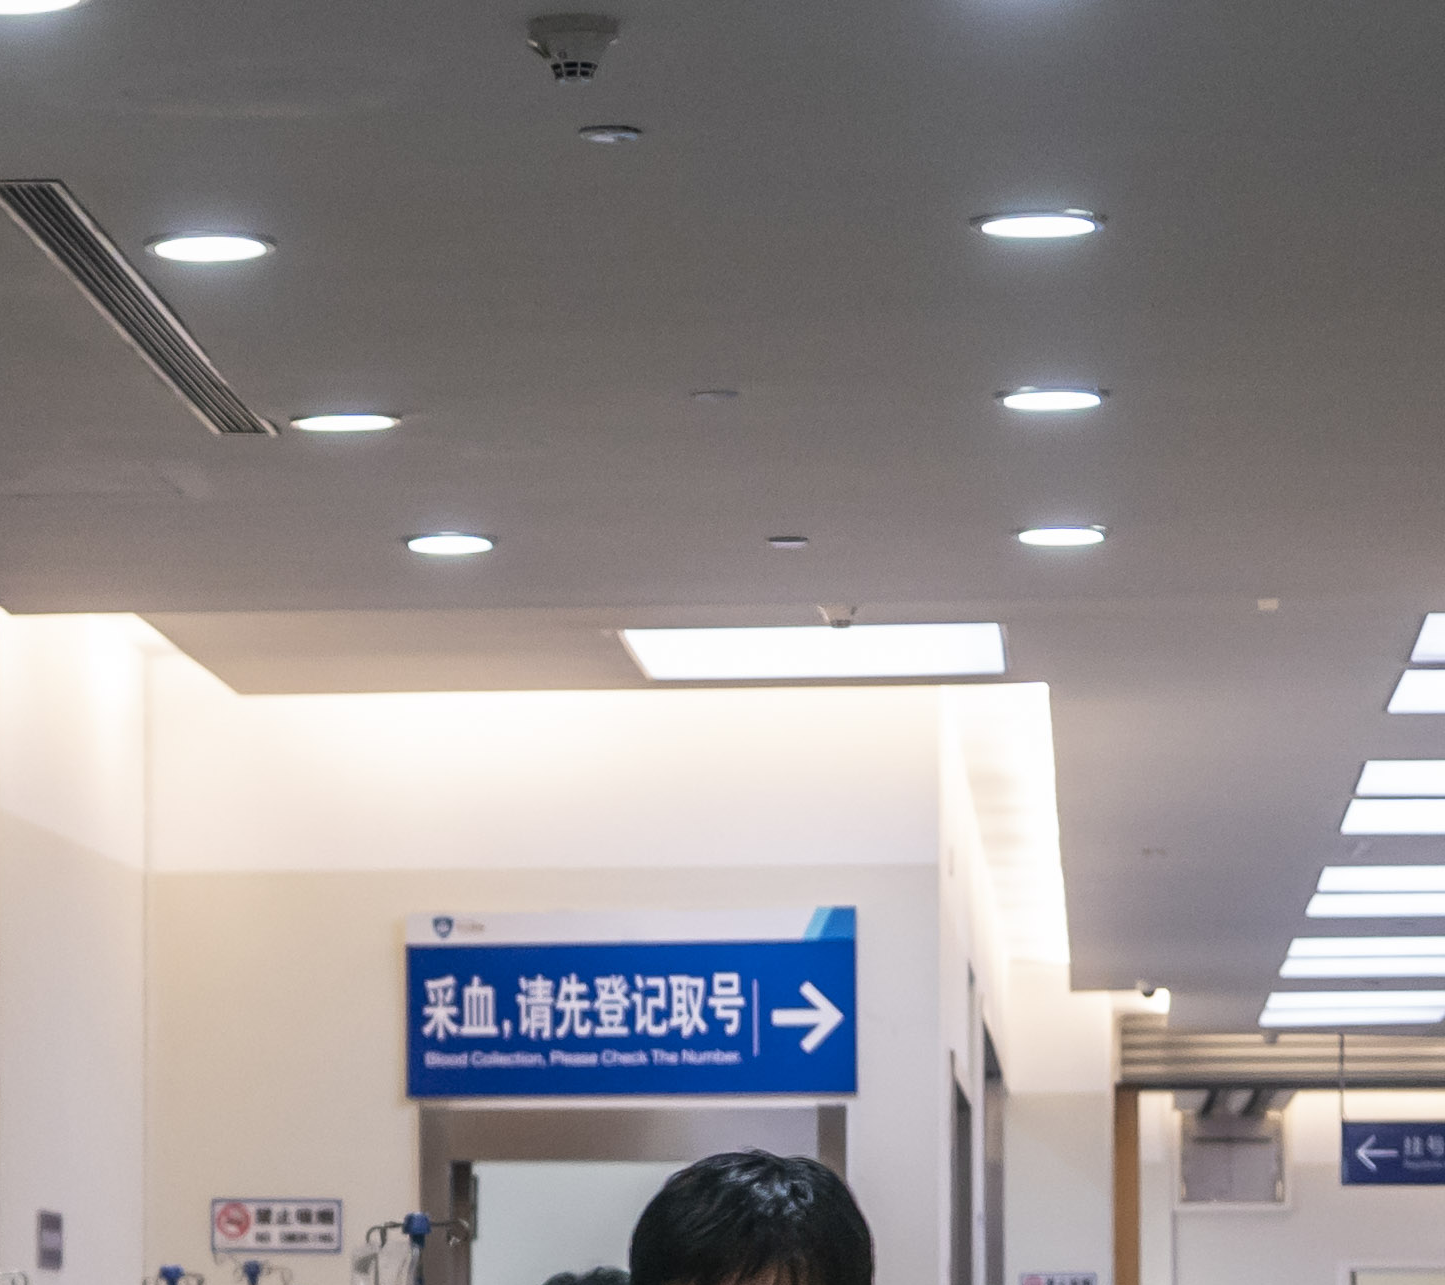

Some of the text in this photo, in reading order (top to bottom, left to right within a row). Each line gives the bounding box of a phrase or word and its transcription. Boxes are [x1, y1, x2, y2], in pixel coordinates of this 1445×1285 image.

[424, 1051, 468, 1068] Blood
[549, 1049, 598, 1067] Please
[601, 1049, 648, 1066] Check
[652, 1049, 679, 1066] The
